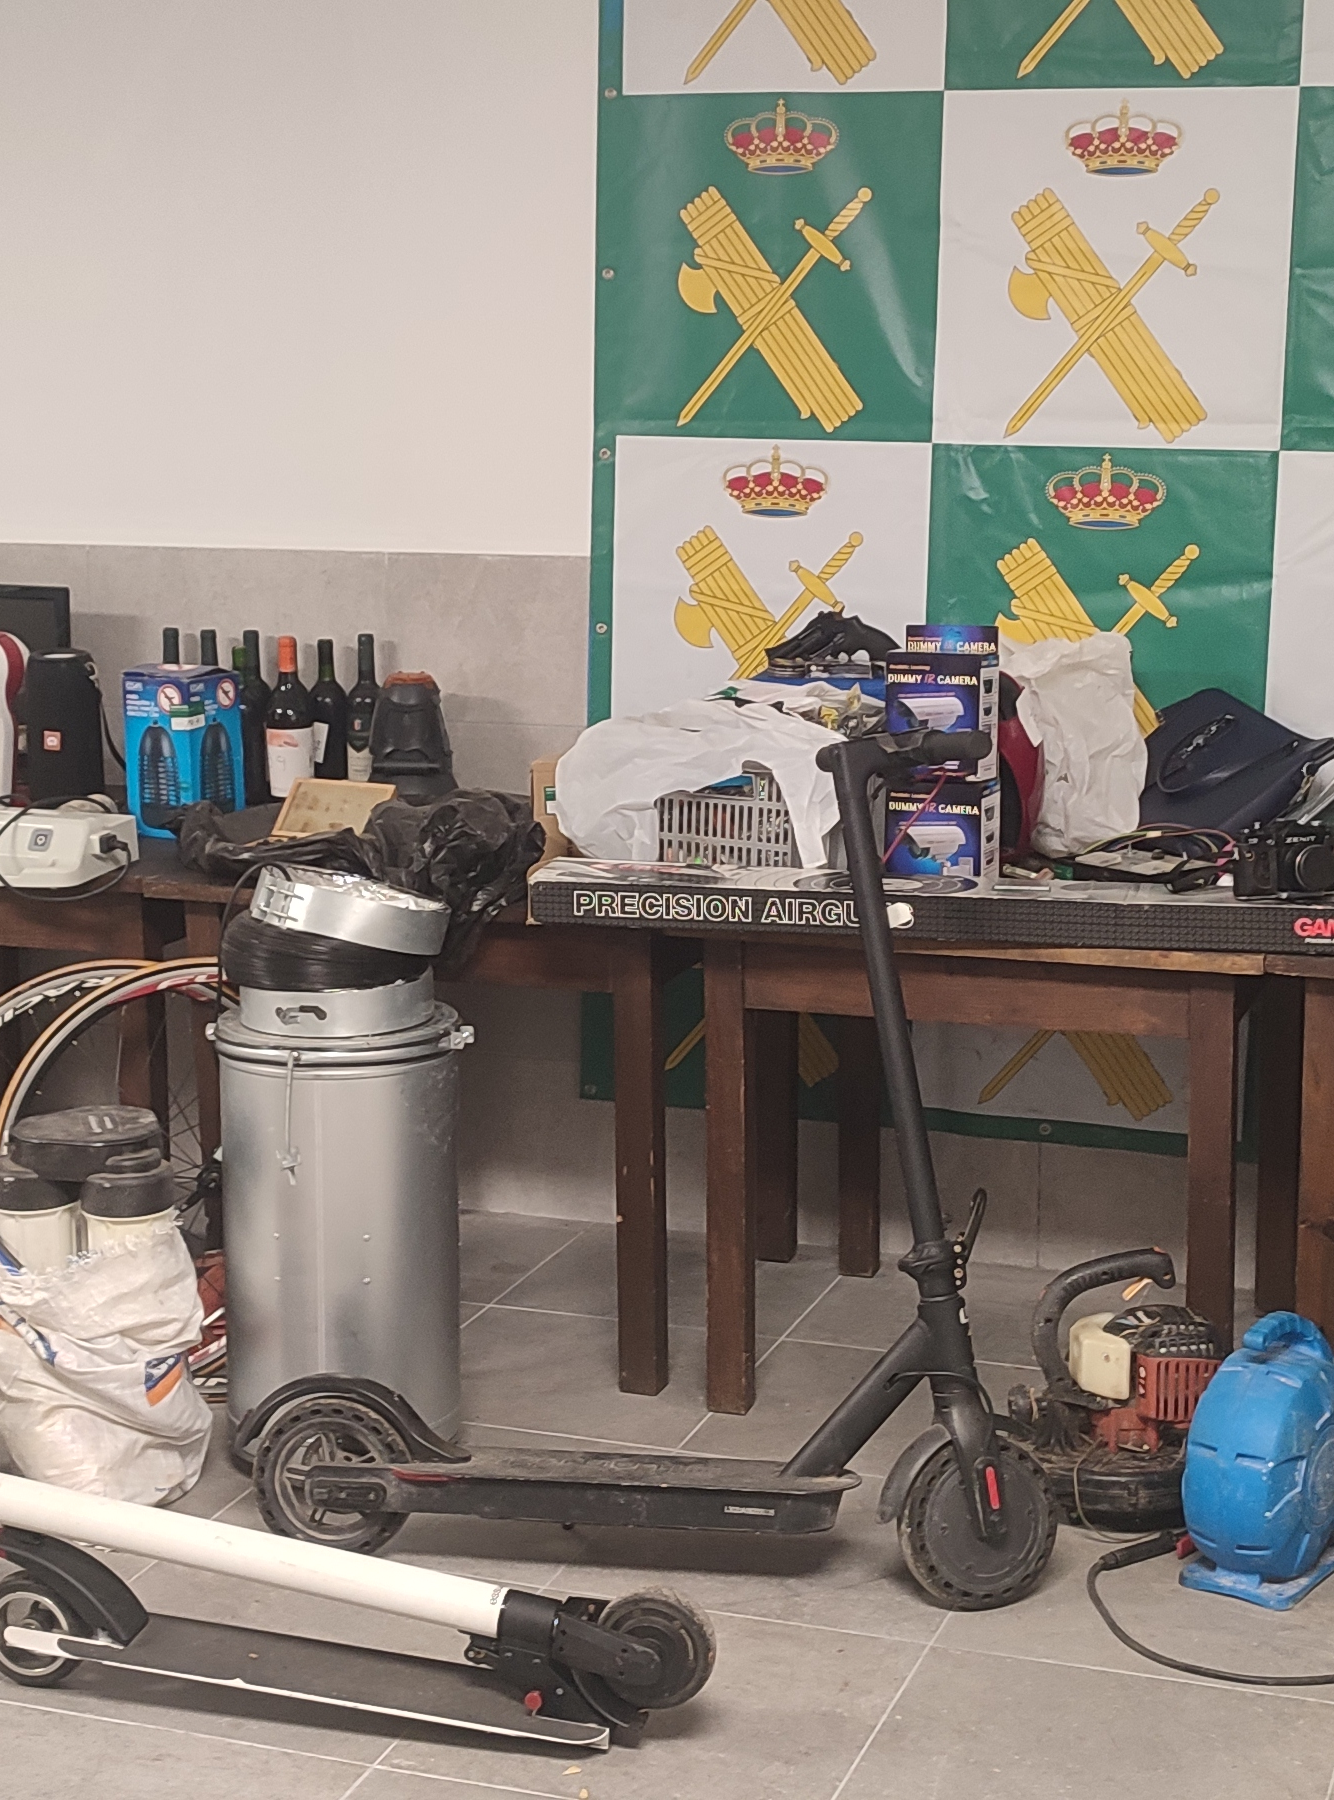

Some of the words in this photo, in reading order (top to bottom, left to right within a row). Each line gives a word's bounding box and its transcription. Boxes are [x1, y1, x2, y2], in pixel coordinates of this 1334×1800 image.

[956, 641, 997, 653] CAMERA
[887, 673, 923, 685] DUMMY
[923, 673, 936, 685] IR
[937, 675, 978, 686] CAMERA
[938, 804, 980, 816] CAMERA
[1285, 835, 1317, 844] ZENIT
[573, 890, 753, 922] PRECISION
